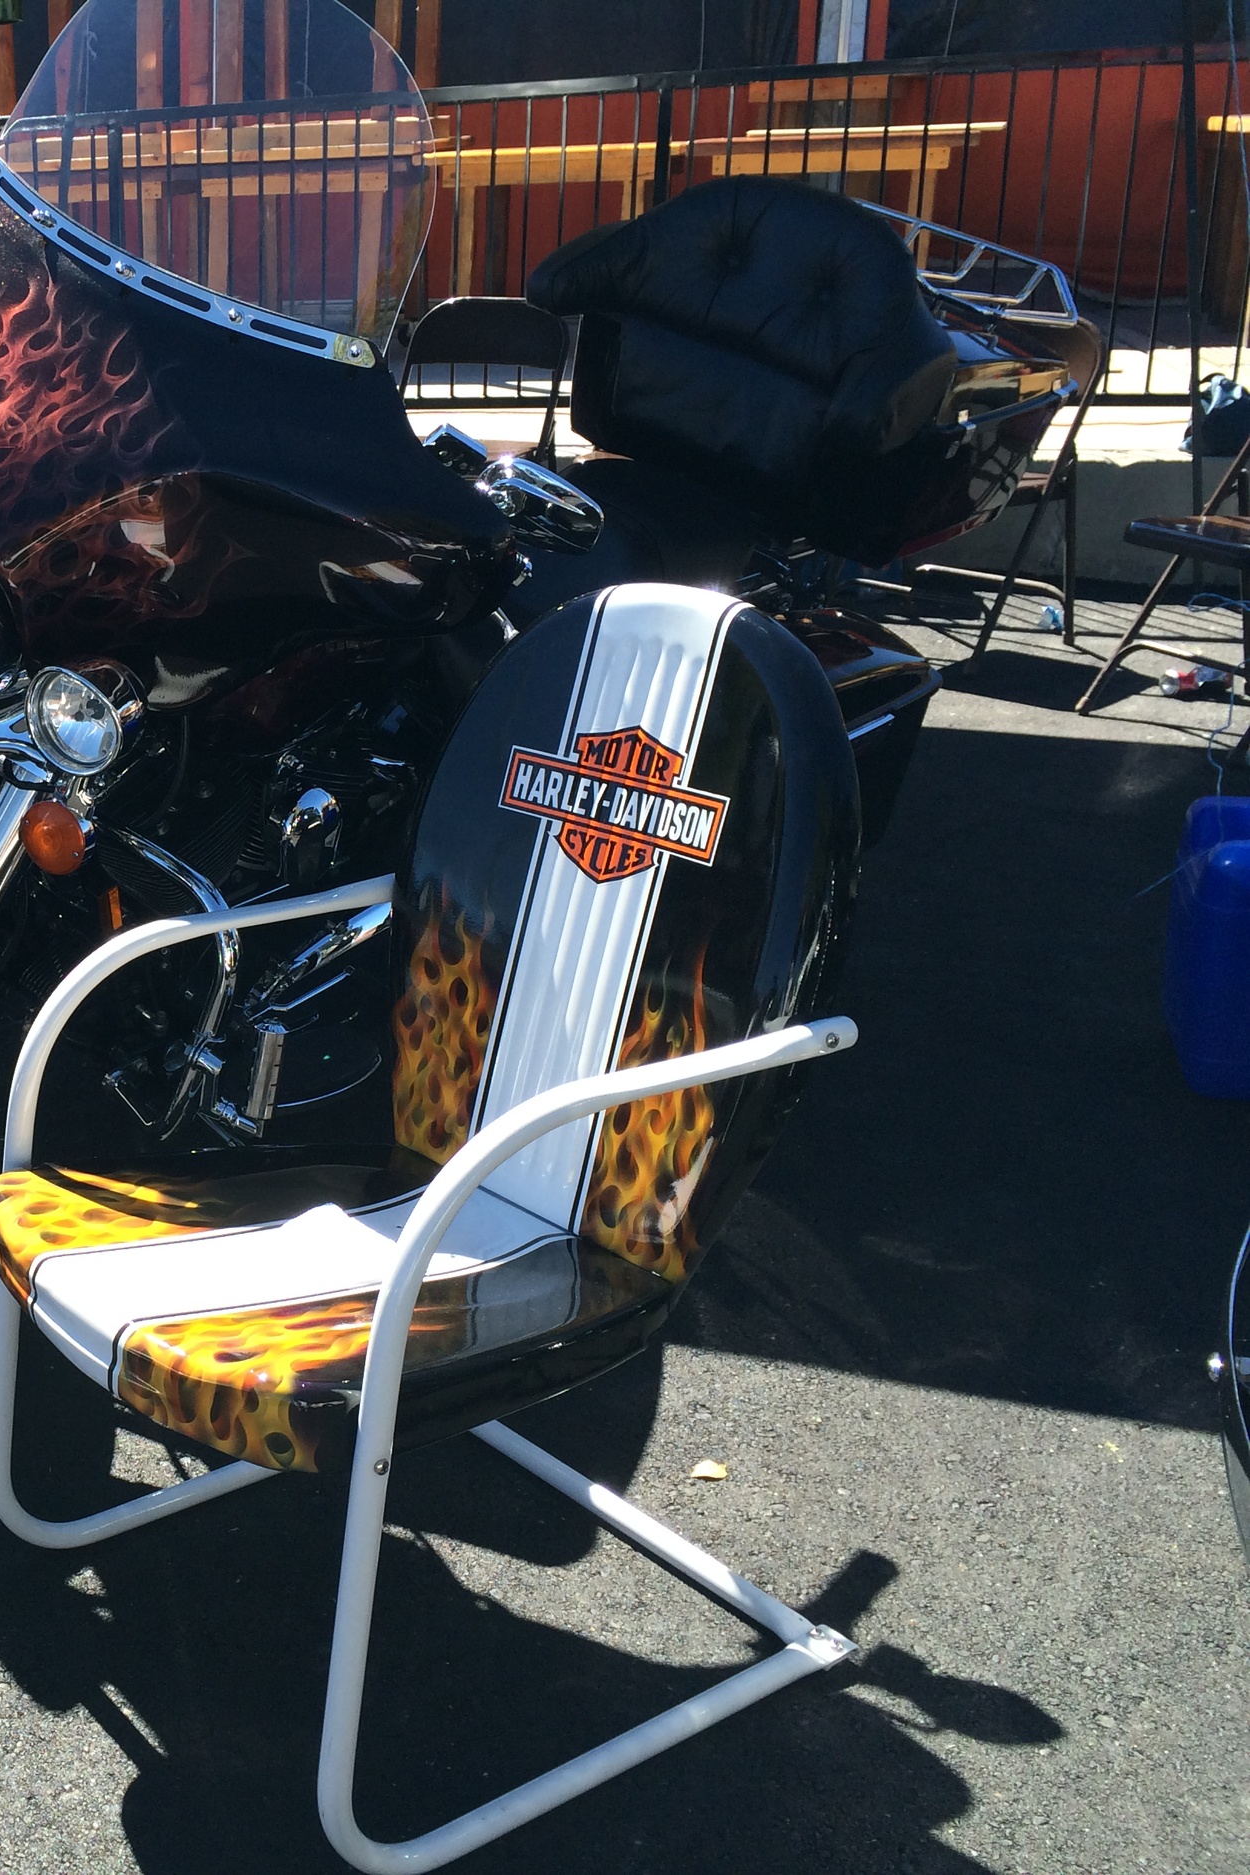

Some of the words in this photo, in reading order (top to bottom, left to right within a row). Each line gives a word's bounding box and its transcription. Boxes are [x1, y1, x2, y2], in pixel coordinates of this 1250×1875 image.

[583, 733, 671, 782] MOTOR
[512, 762, 716, 850] HARLEY-DAVIDSON
[564, 828, 647, 876] CYCLES
